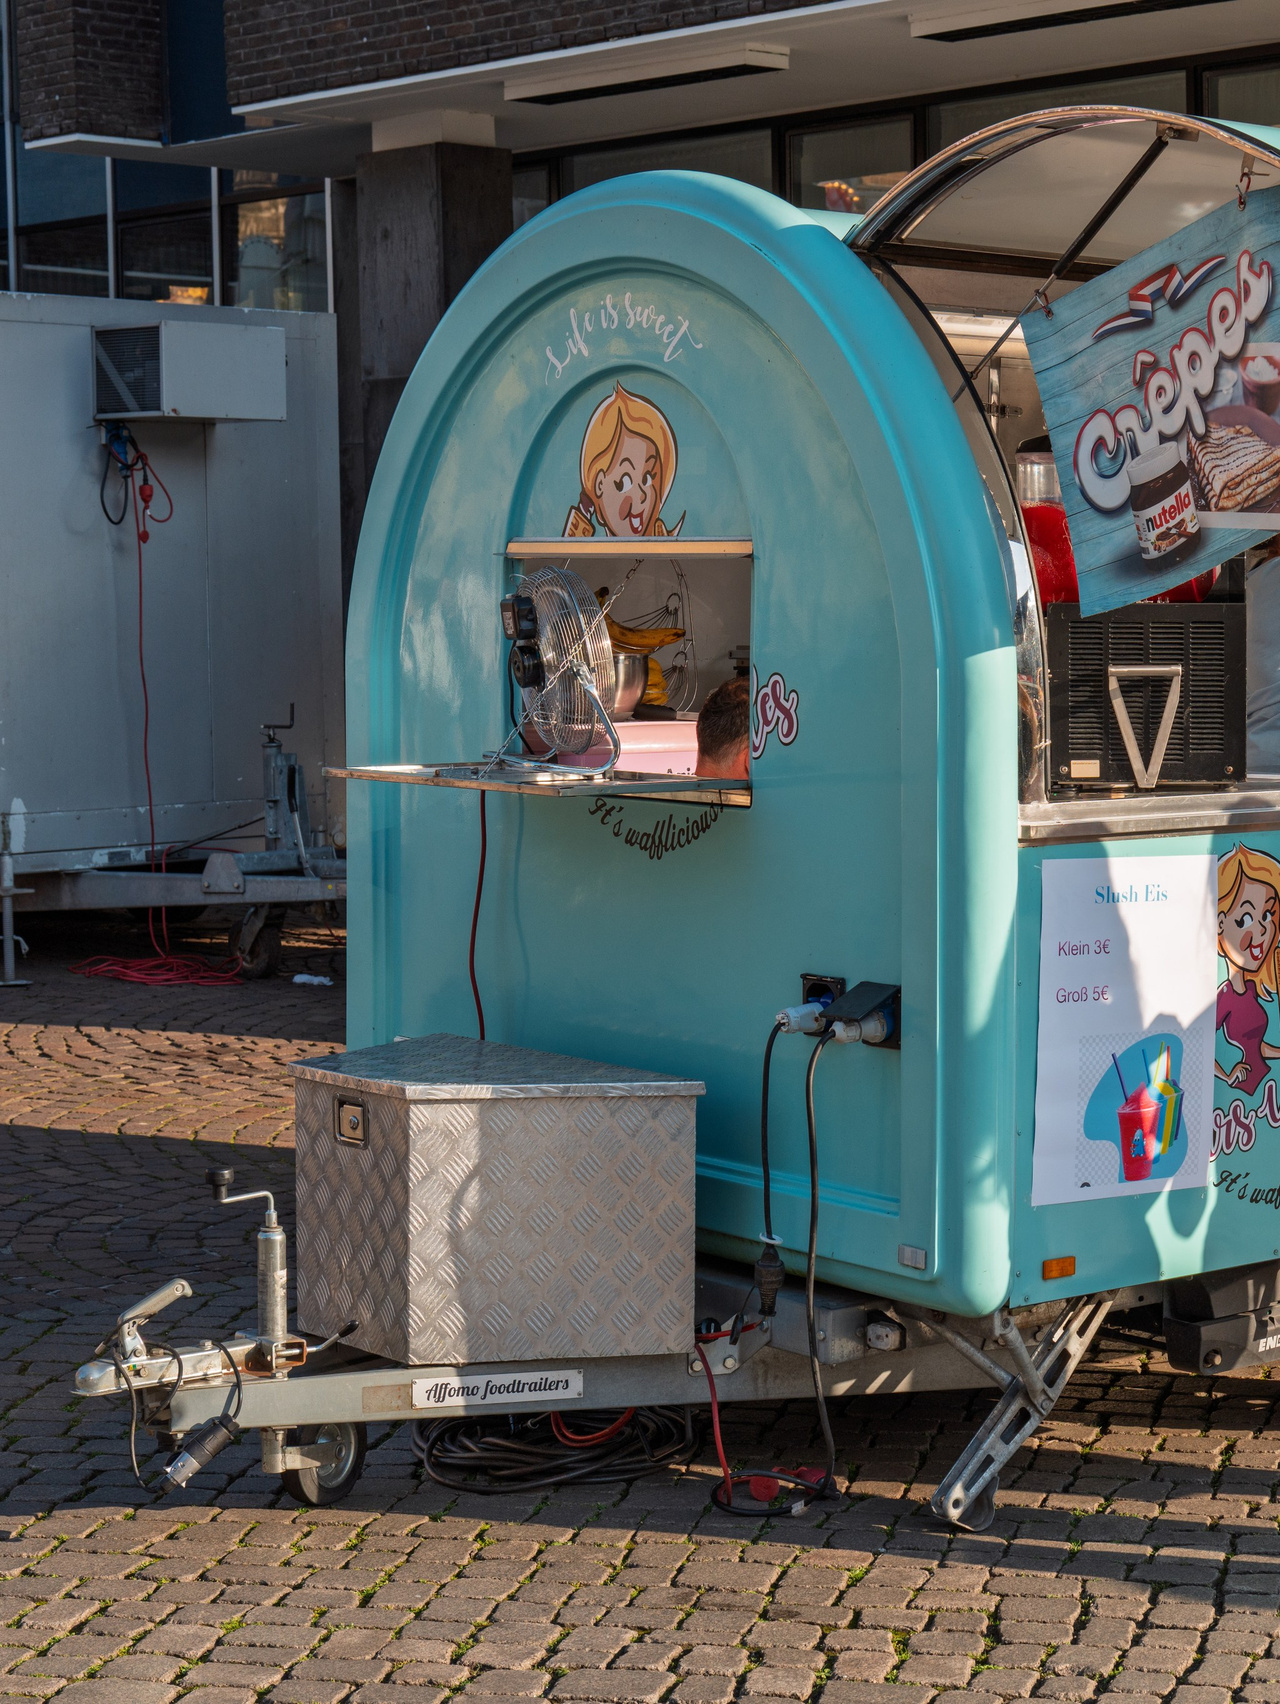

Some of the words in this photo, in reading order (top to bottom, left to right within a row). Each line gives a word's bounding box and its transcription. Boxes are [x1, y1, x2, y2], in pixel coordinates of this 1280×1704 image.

[1073, 249, 1272, 515] Crêpes
[1145, 491, 1192, 533] nutella
[587, 797, 624, 837] It's
[1094, 885, 1138, 905] Slush
[1145, 884, 1168, 902] Eis
[1058, 940, 1090, 957] Klein
[1094, 938, 1111, 955] 3€
[1056, 986, 1088, 1004] Groß
[1092, 985, 1109, 1001] 5€
[1213, 1169, 1251, 1200] It's
[425, 1382, 481, 1404] Affomo
[480, 1376, 570, 1401] foodtrailers
